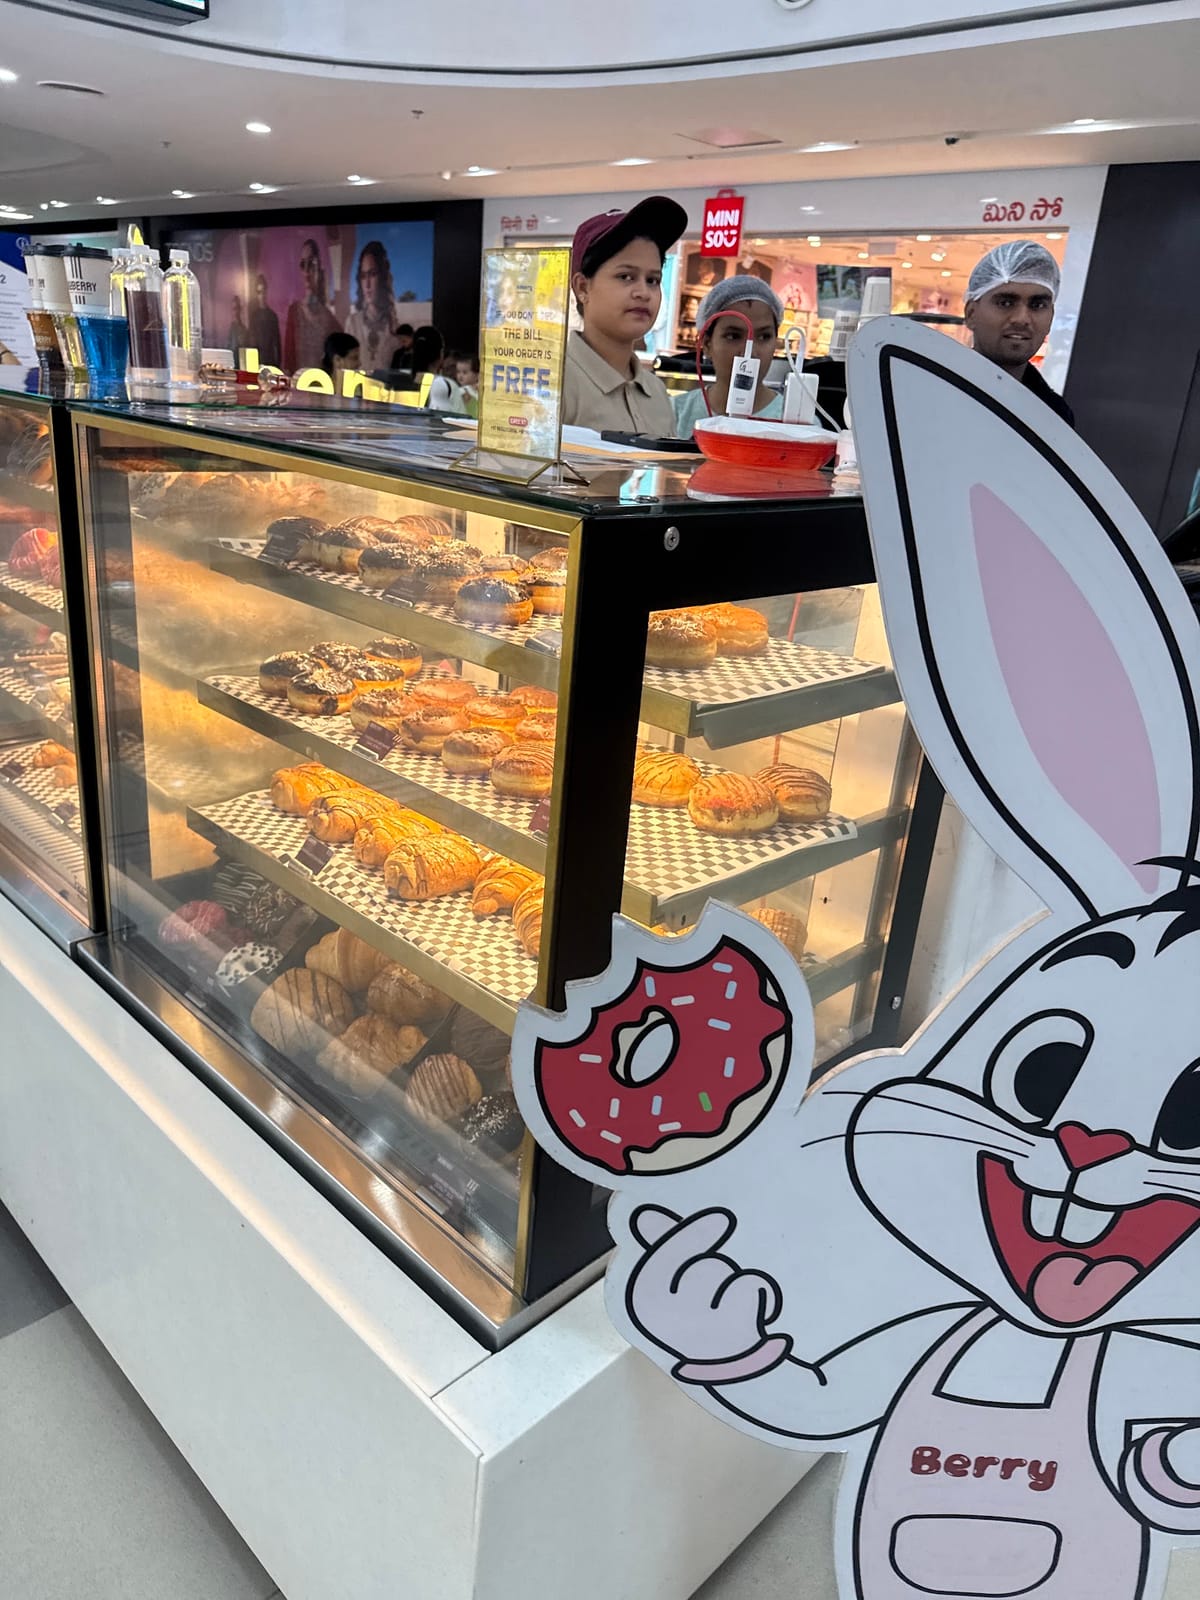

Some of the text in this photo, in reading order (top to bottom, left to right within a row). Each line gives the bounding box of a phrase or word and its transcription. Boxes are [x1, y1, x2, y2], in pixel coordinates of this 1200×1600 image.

[706, 209, 740, 227] MINI
[983, 197, 1064, 222] మిని సో
[503, 327, 543, 341] THE BILL
[493, 347, 552, 360] YOUR ORDER IS
[492, 365, 551, 397] FREE
[910, 1445, 1058, 1492] Berry
